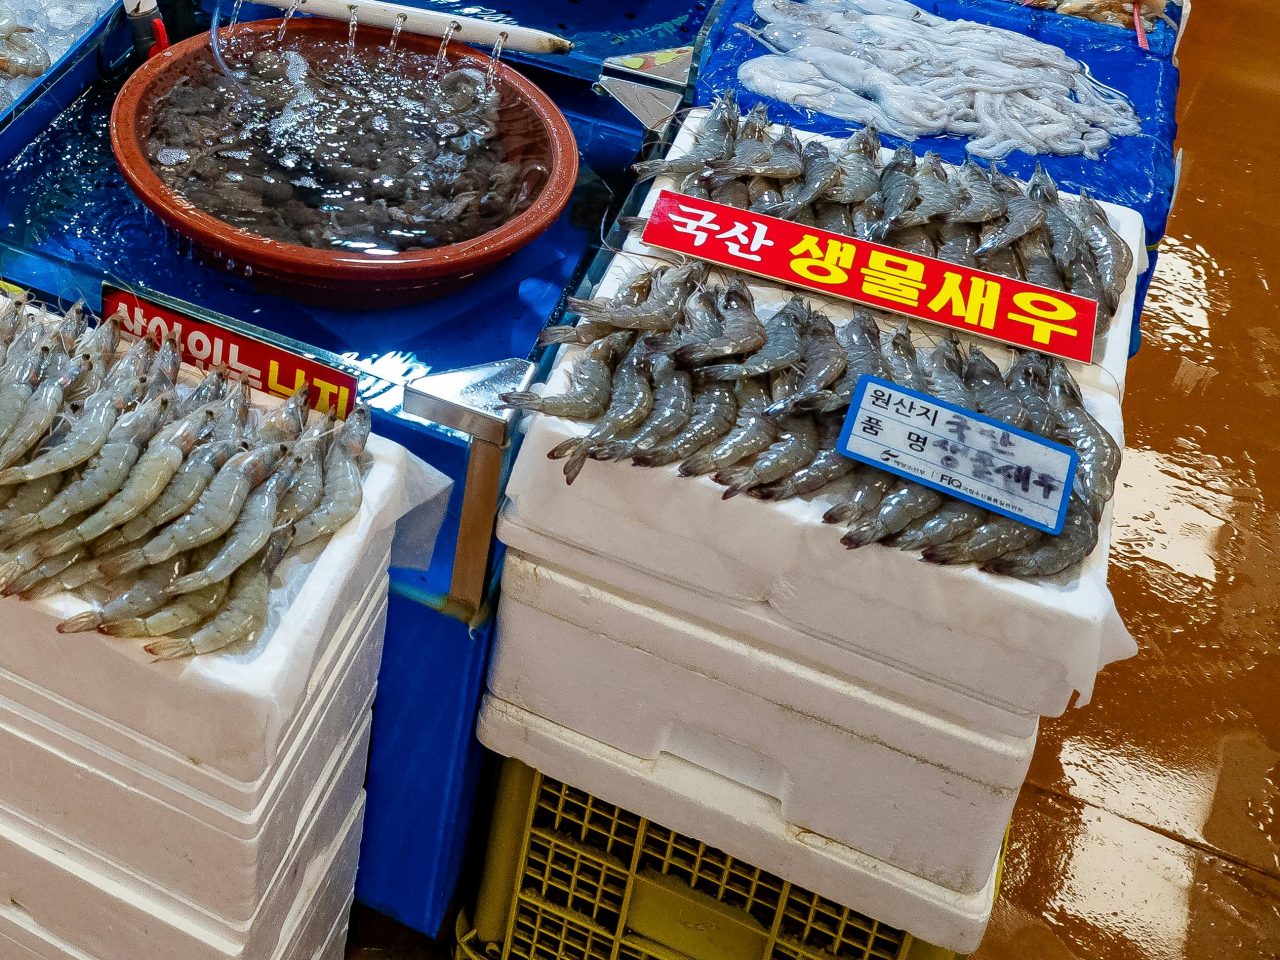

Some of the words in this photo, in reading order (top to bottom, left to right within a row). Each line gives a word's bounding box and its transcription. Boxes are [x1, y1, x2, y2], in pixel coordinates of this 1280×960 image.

[668, 204, 774, 262] 국산
[789, 234, 1078, 345] 생물새우
[870, 389, 939, 427] 원산지
[945, 413, 1016, 457] 국산
[939, 473, 963, 490] FIQ
